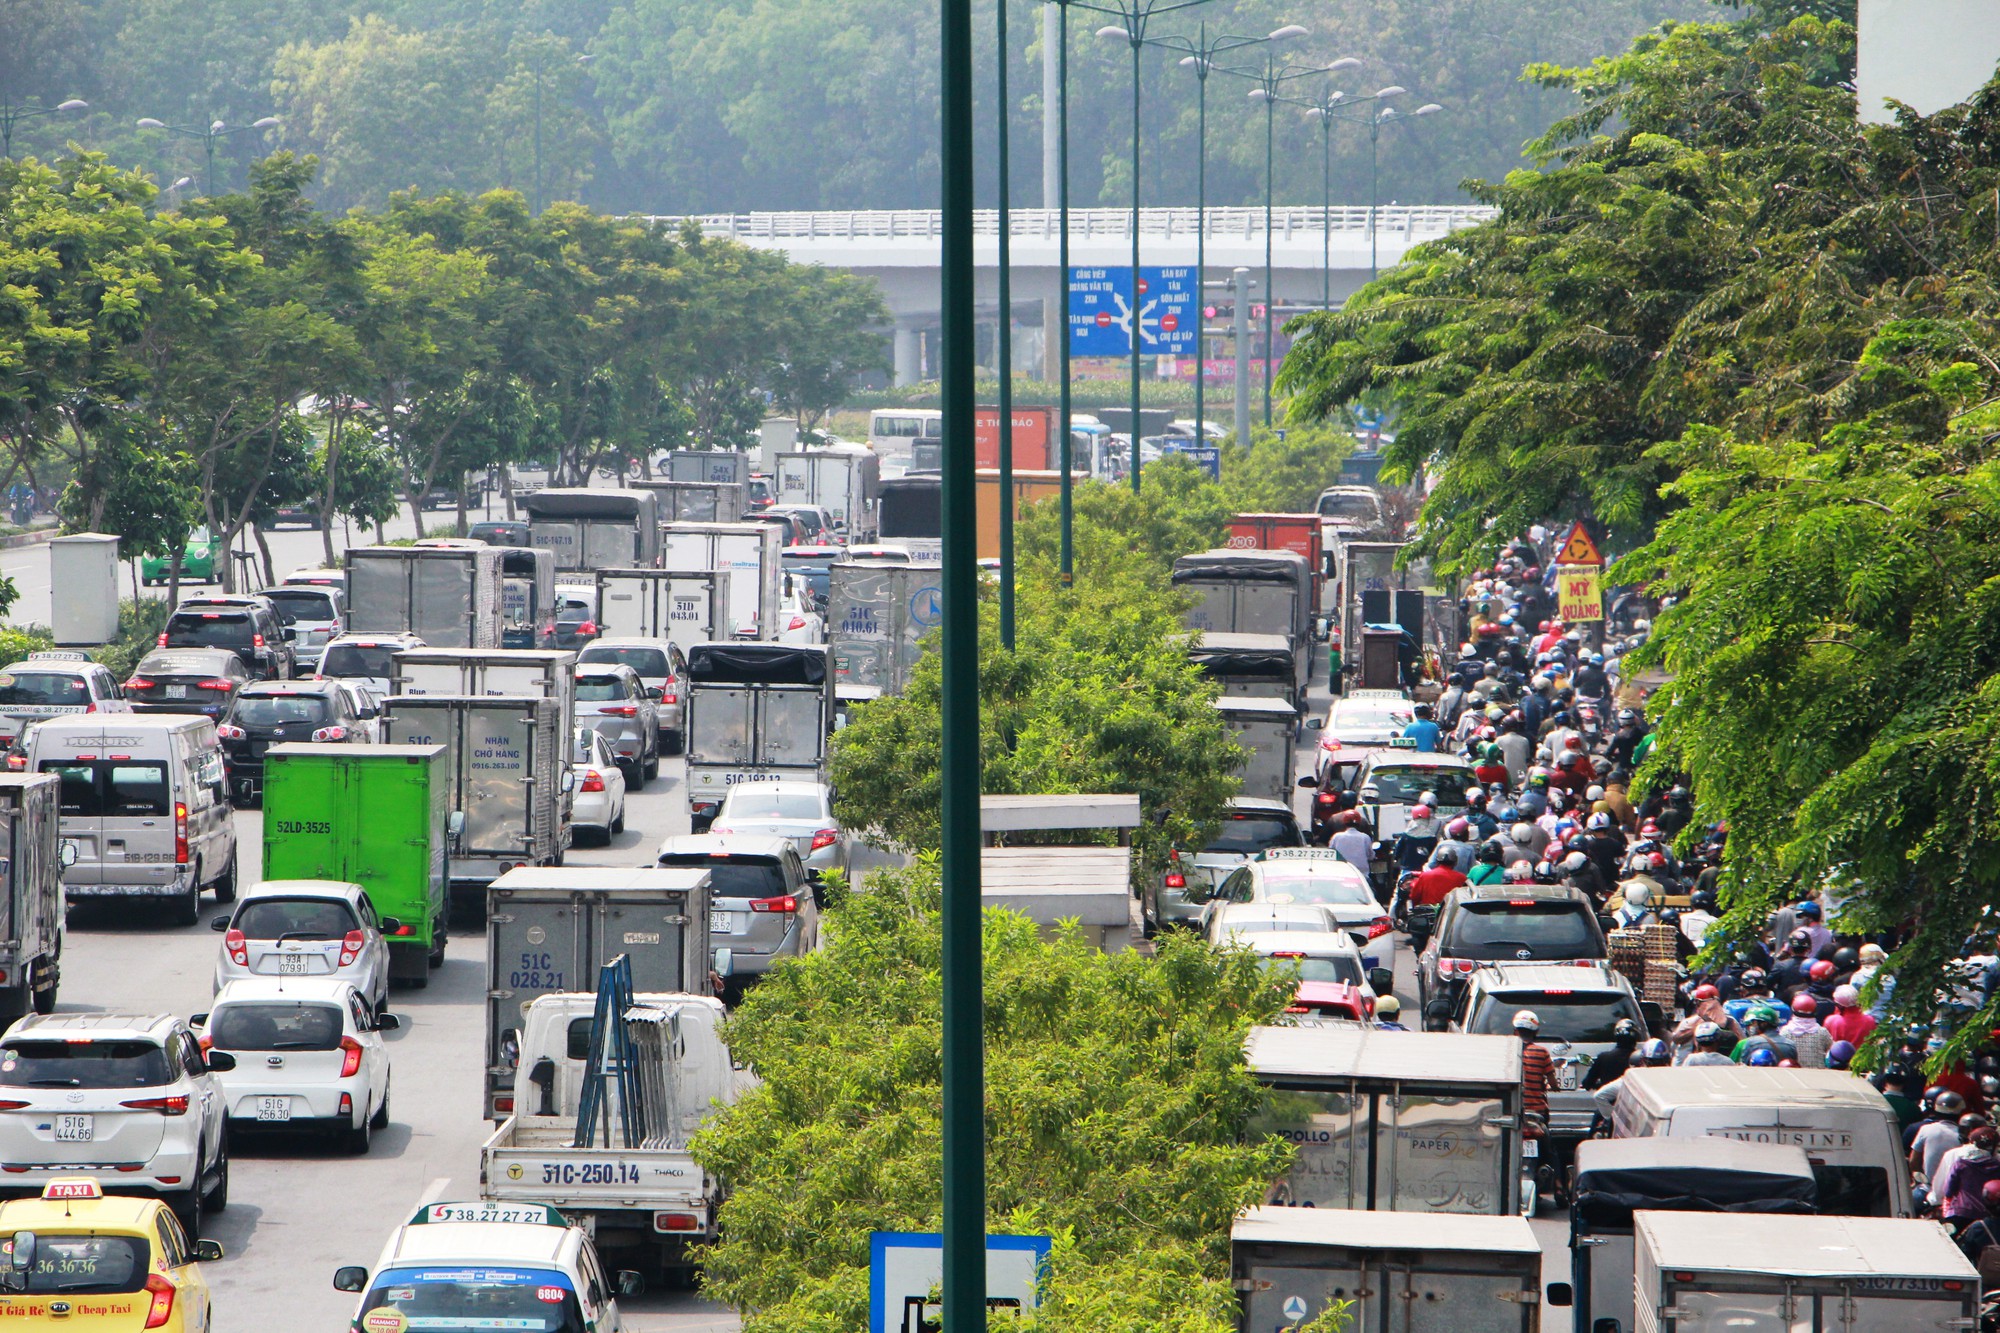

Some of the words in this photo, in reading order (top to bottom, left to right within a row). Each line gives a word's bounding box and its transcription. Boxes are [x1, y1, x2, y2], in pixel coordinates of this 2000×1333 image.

[676, 602, 694, 611] 51D
[849, 607, 872, 620] 51C
[64, 736, 143, 747] LUXURY
[408, 736, 432, 745] 51C
[484, 737, 509, 747] NHẬN
[474, 747, 493, 759] CHỞ
[277, 821, 331, 834] 52LD-3525
[124, 853, 176, 863] 51B-129.86
[1310, 850, 1322, 858] 27
[1323, 851, 1335, 859] 27
[285, 954, 301, 964] 93A
[521, 953, 551, 970] 51C
[280, 964, 307, 973] 079.91
[510, 972, 564, 989] 028.21
[265, 1098, 283, 1109] 51G
[258, 1109, 289, 1120] 256.30
[64, 1117, 84, 1128] 51G
[56, 1129, 91, 1140] 444.66
[1412, 1139, 1451, 1151] PAPER
[654, 1168, 684, 1177] THACO
[54, 1185, 88, 1196] TAXI
[456, 1210, 499, 1222] 38.27
[503, 1211, 520, 1222] 27
[524, 1212, 542, 1223] 27
[37, 1259, 54, 1274] 36
[58, 1259, 75, 1274] 36
[79, 1259, 96, 1275] 36
[538, 1288, 564, 1301] 6804
[6, 1304, 26, 1316] Giá
[29, 1303, 44, 1316] Rẻ
[77, 1304, 107, 1316] Cheap
[109, 1303, 132, 1315] Taxi
